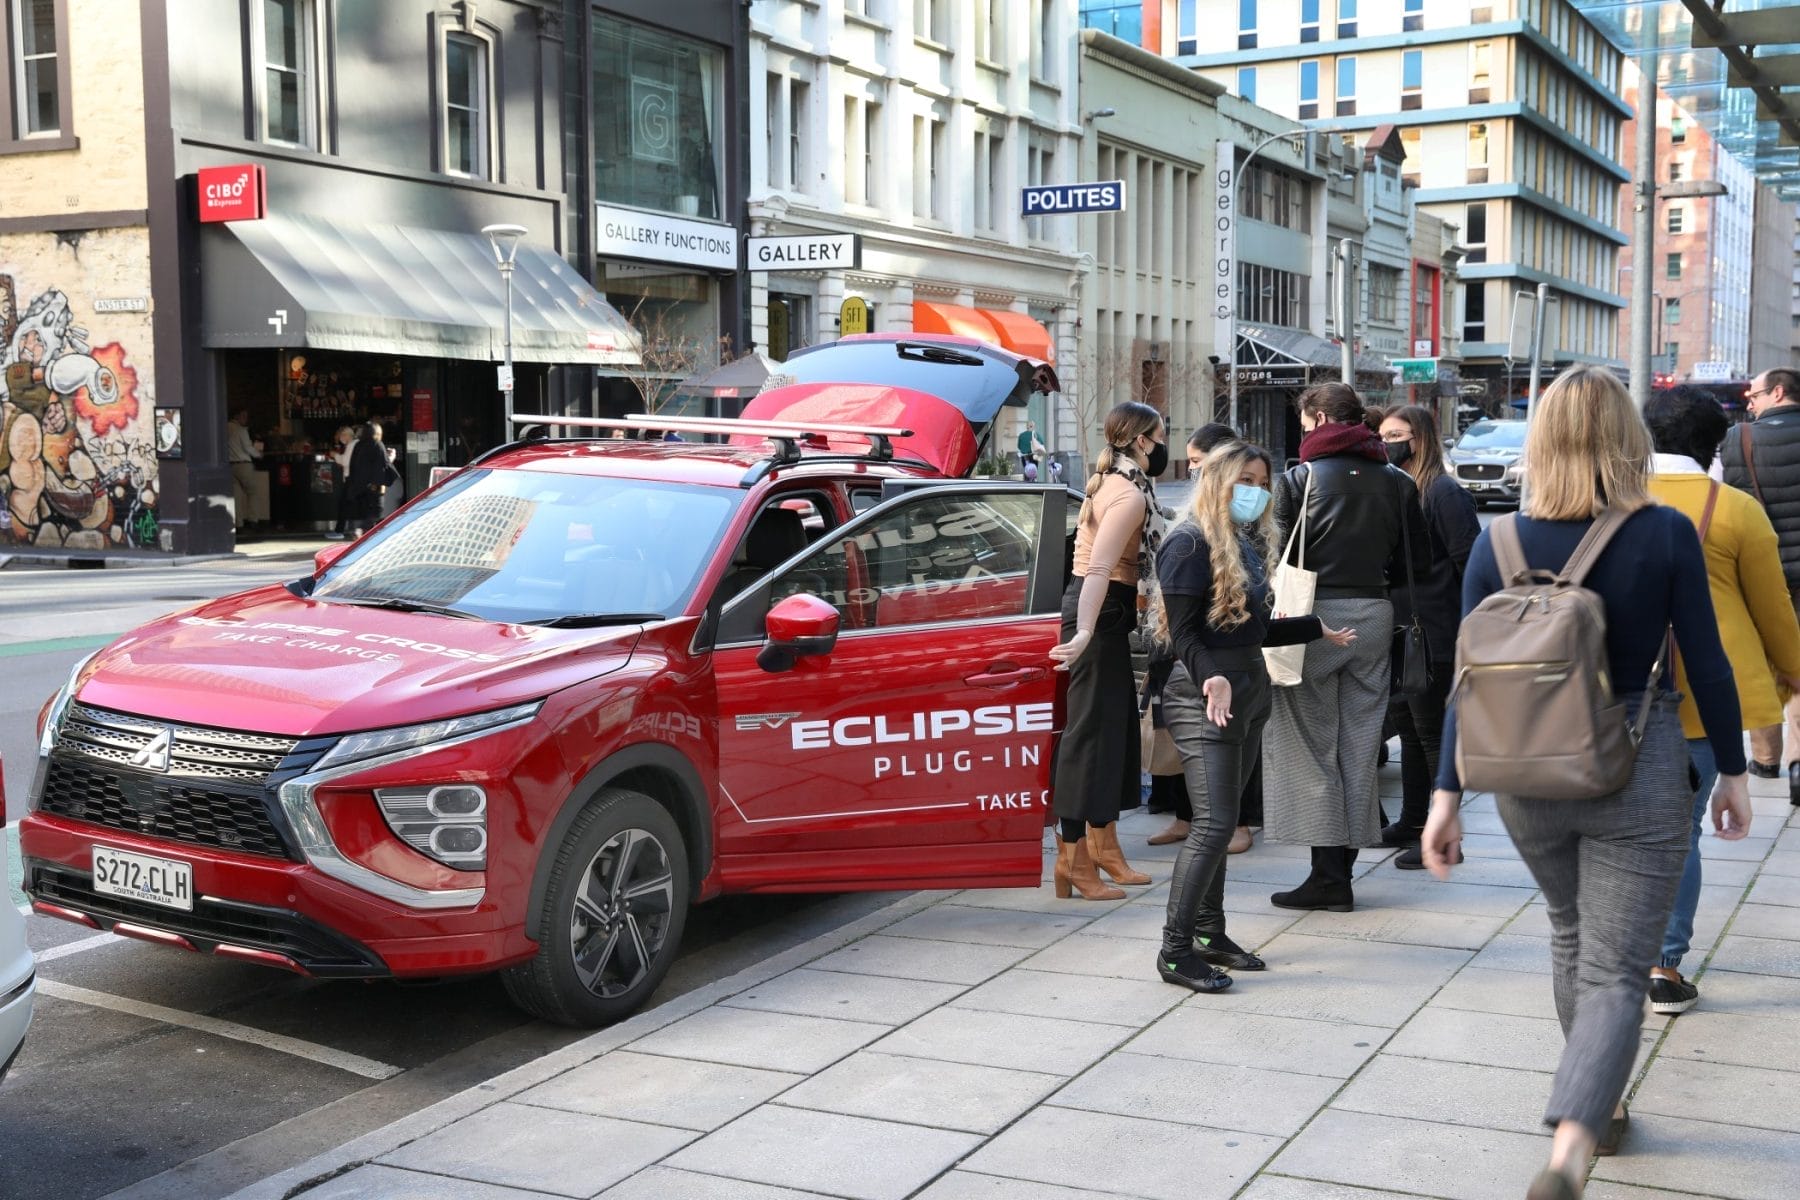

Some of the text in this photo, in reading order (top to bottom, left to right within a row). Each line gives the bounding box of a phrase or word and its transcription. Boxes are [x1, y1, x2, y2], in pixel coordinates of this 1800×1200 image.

[640, 94, 669, 149] G
[207, 183, 242, 199] CIBO
[1027, 187, 1115, 211] POLITES
[605, 223, 731, 255] GALLERY FUNCTIONS
[1217, 169, 1231, 320] georges
[758, 243, 842, 263] GALLERY
[130, 300, 140, 309] ST
[1225, 371, 1272, 381] gorges
[178, 616, 501, 663] ECLIPSE CROSS
[213, 632, 400, 663] TAKE CHARGE
[791, 702, 1053, 750] ECLIPSE
[874, 745, 1040, 779] PLUG-IN
[976, 791, 1032, 811] TAKE
[113, 886, 172, 904] SOUTH AUSTRALIA
